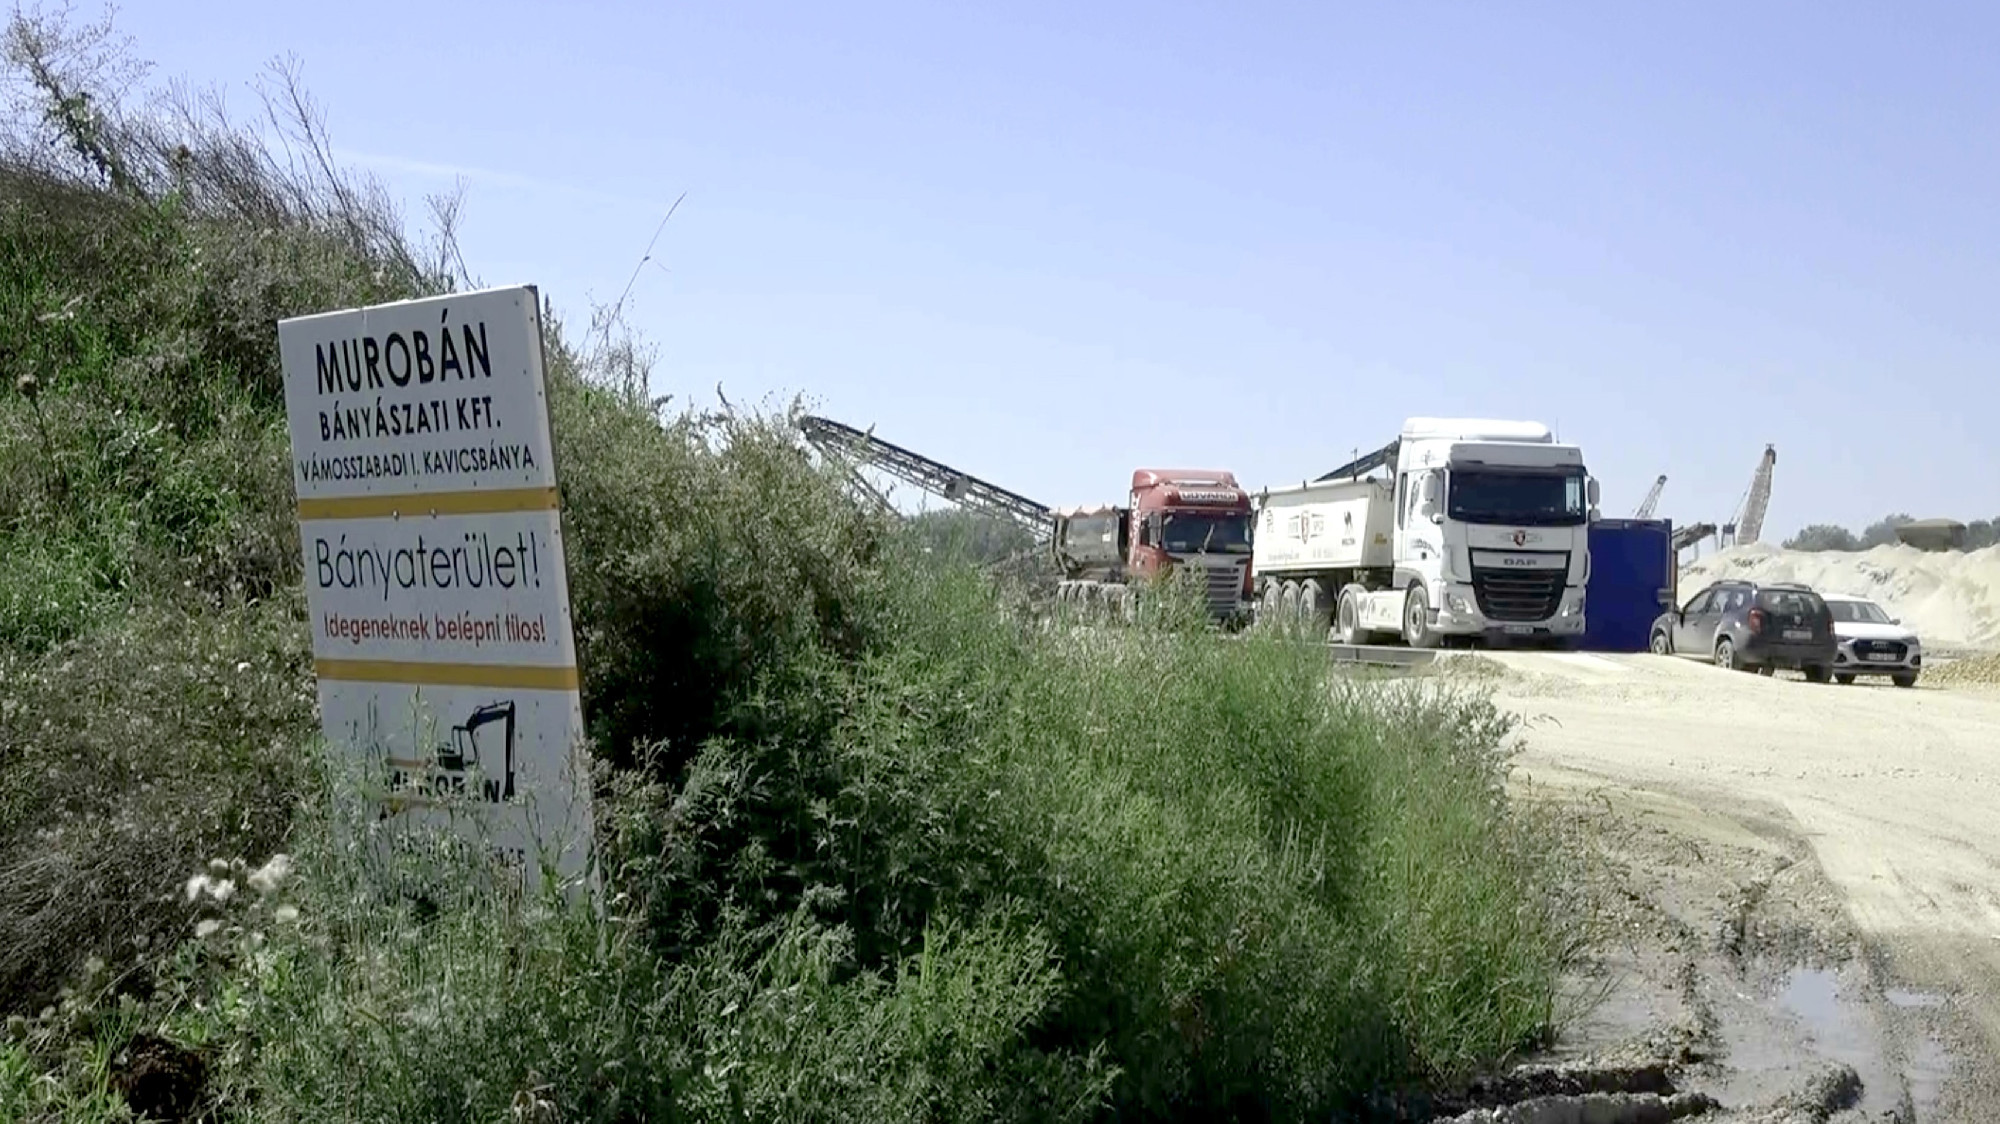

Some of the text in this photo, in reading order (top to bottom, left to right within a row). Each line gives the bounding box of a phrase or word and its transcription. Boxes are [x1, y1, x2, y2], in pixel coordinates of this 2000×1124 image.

[316, 308, 492, 395] MUROBÁN
[319, 395, 501, 441] BÁNYÁSZATI KFT.
[300, 452, 408, 482] VÁMOSSZABADI
[315, 531, 540, 601] Bányaterület!
[324, 610, 547, 648] Idegeneknek belépni tilos!
